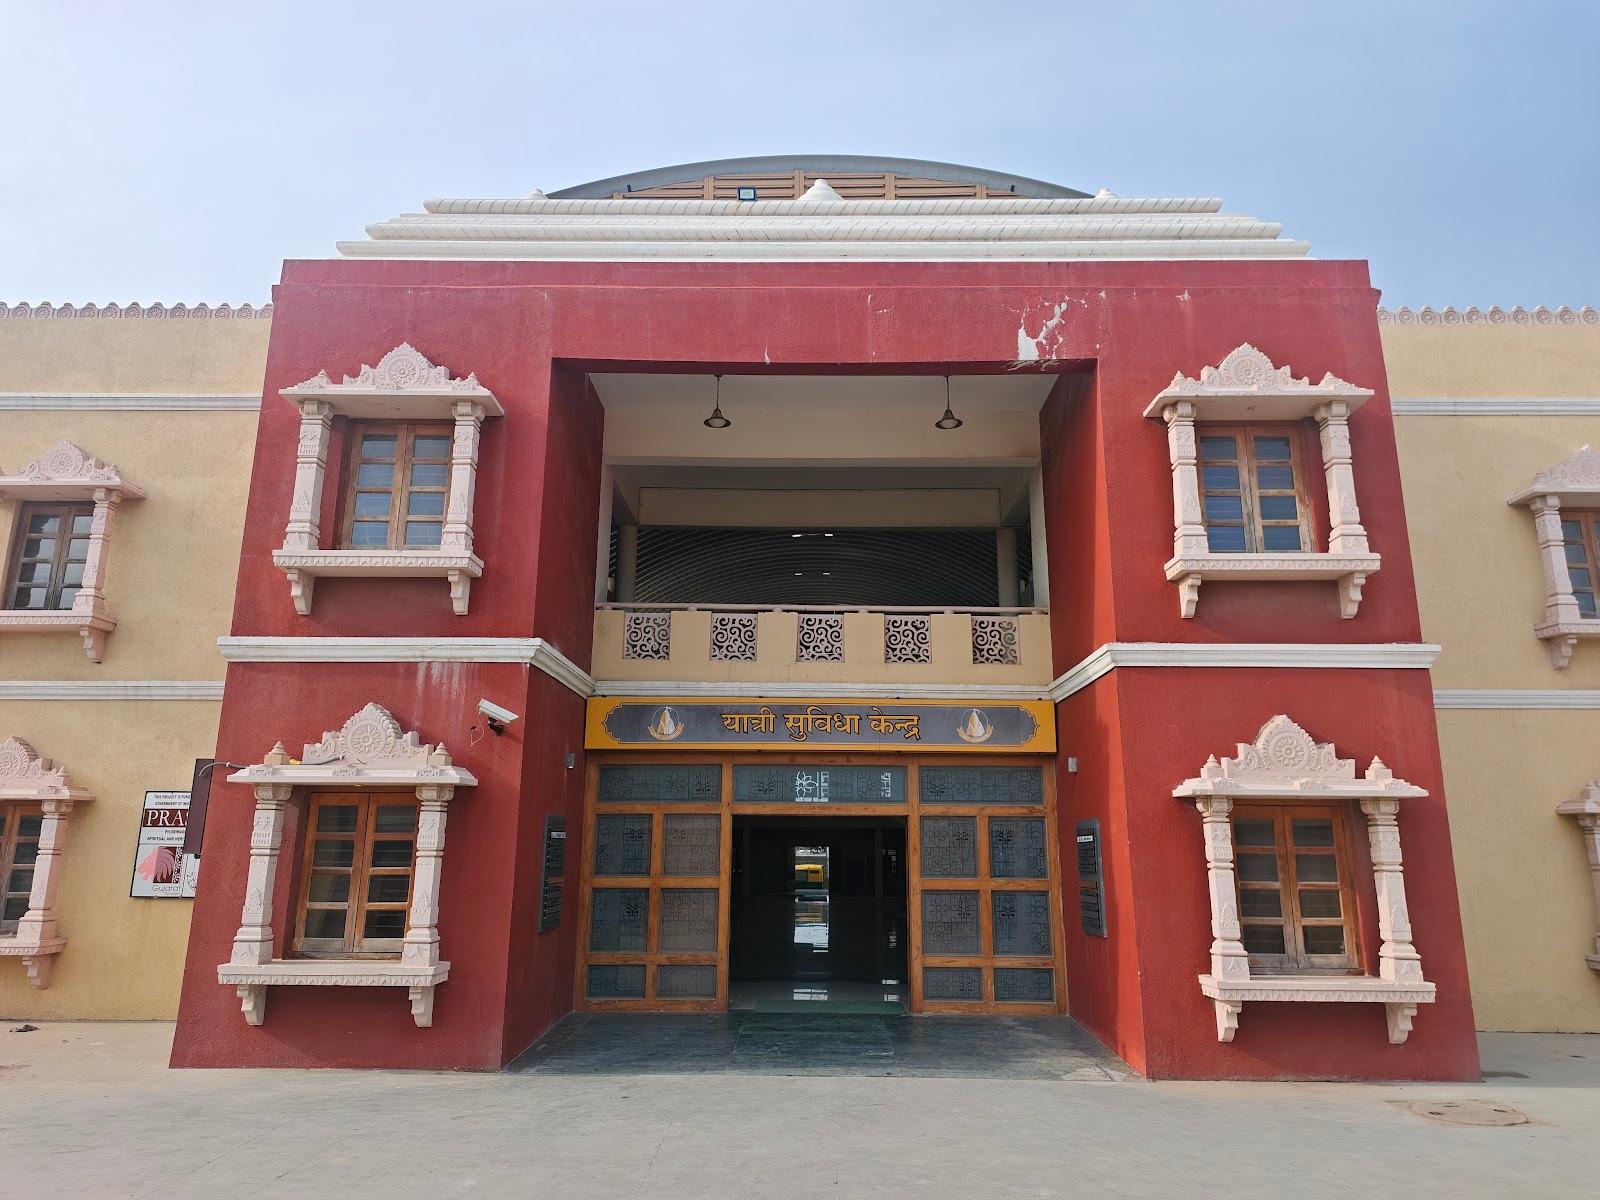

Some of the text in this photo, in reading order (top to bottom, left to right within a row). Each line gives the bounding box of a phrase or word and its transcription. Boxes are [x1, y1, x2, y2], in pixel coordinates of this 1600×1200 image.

[720, 705, 777, 734] यात्री
[783, 705, 863, 742] सुविधा
[867, 706, 922, 741] केन्द्र
[152, 884, 181, 893] Gujarat
